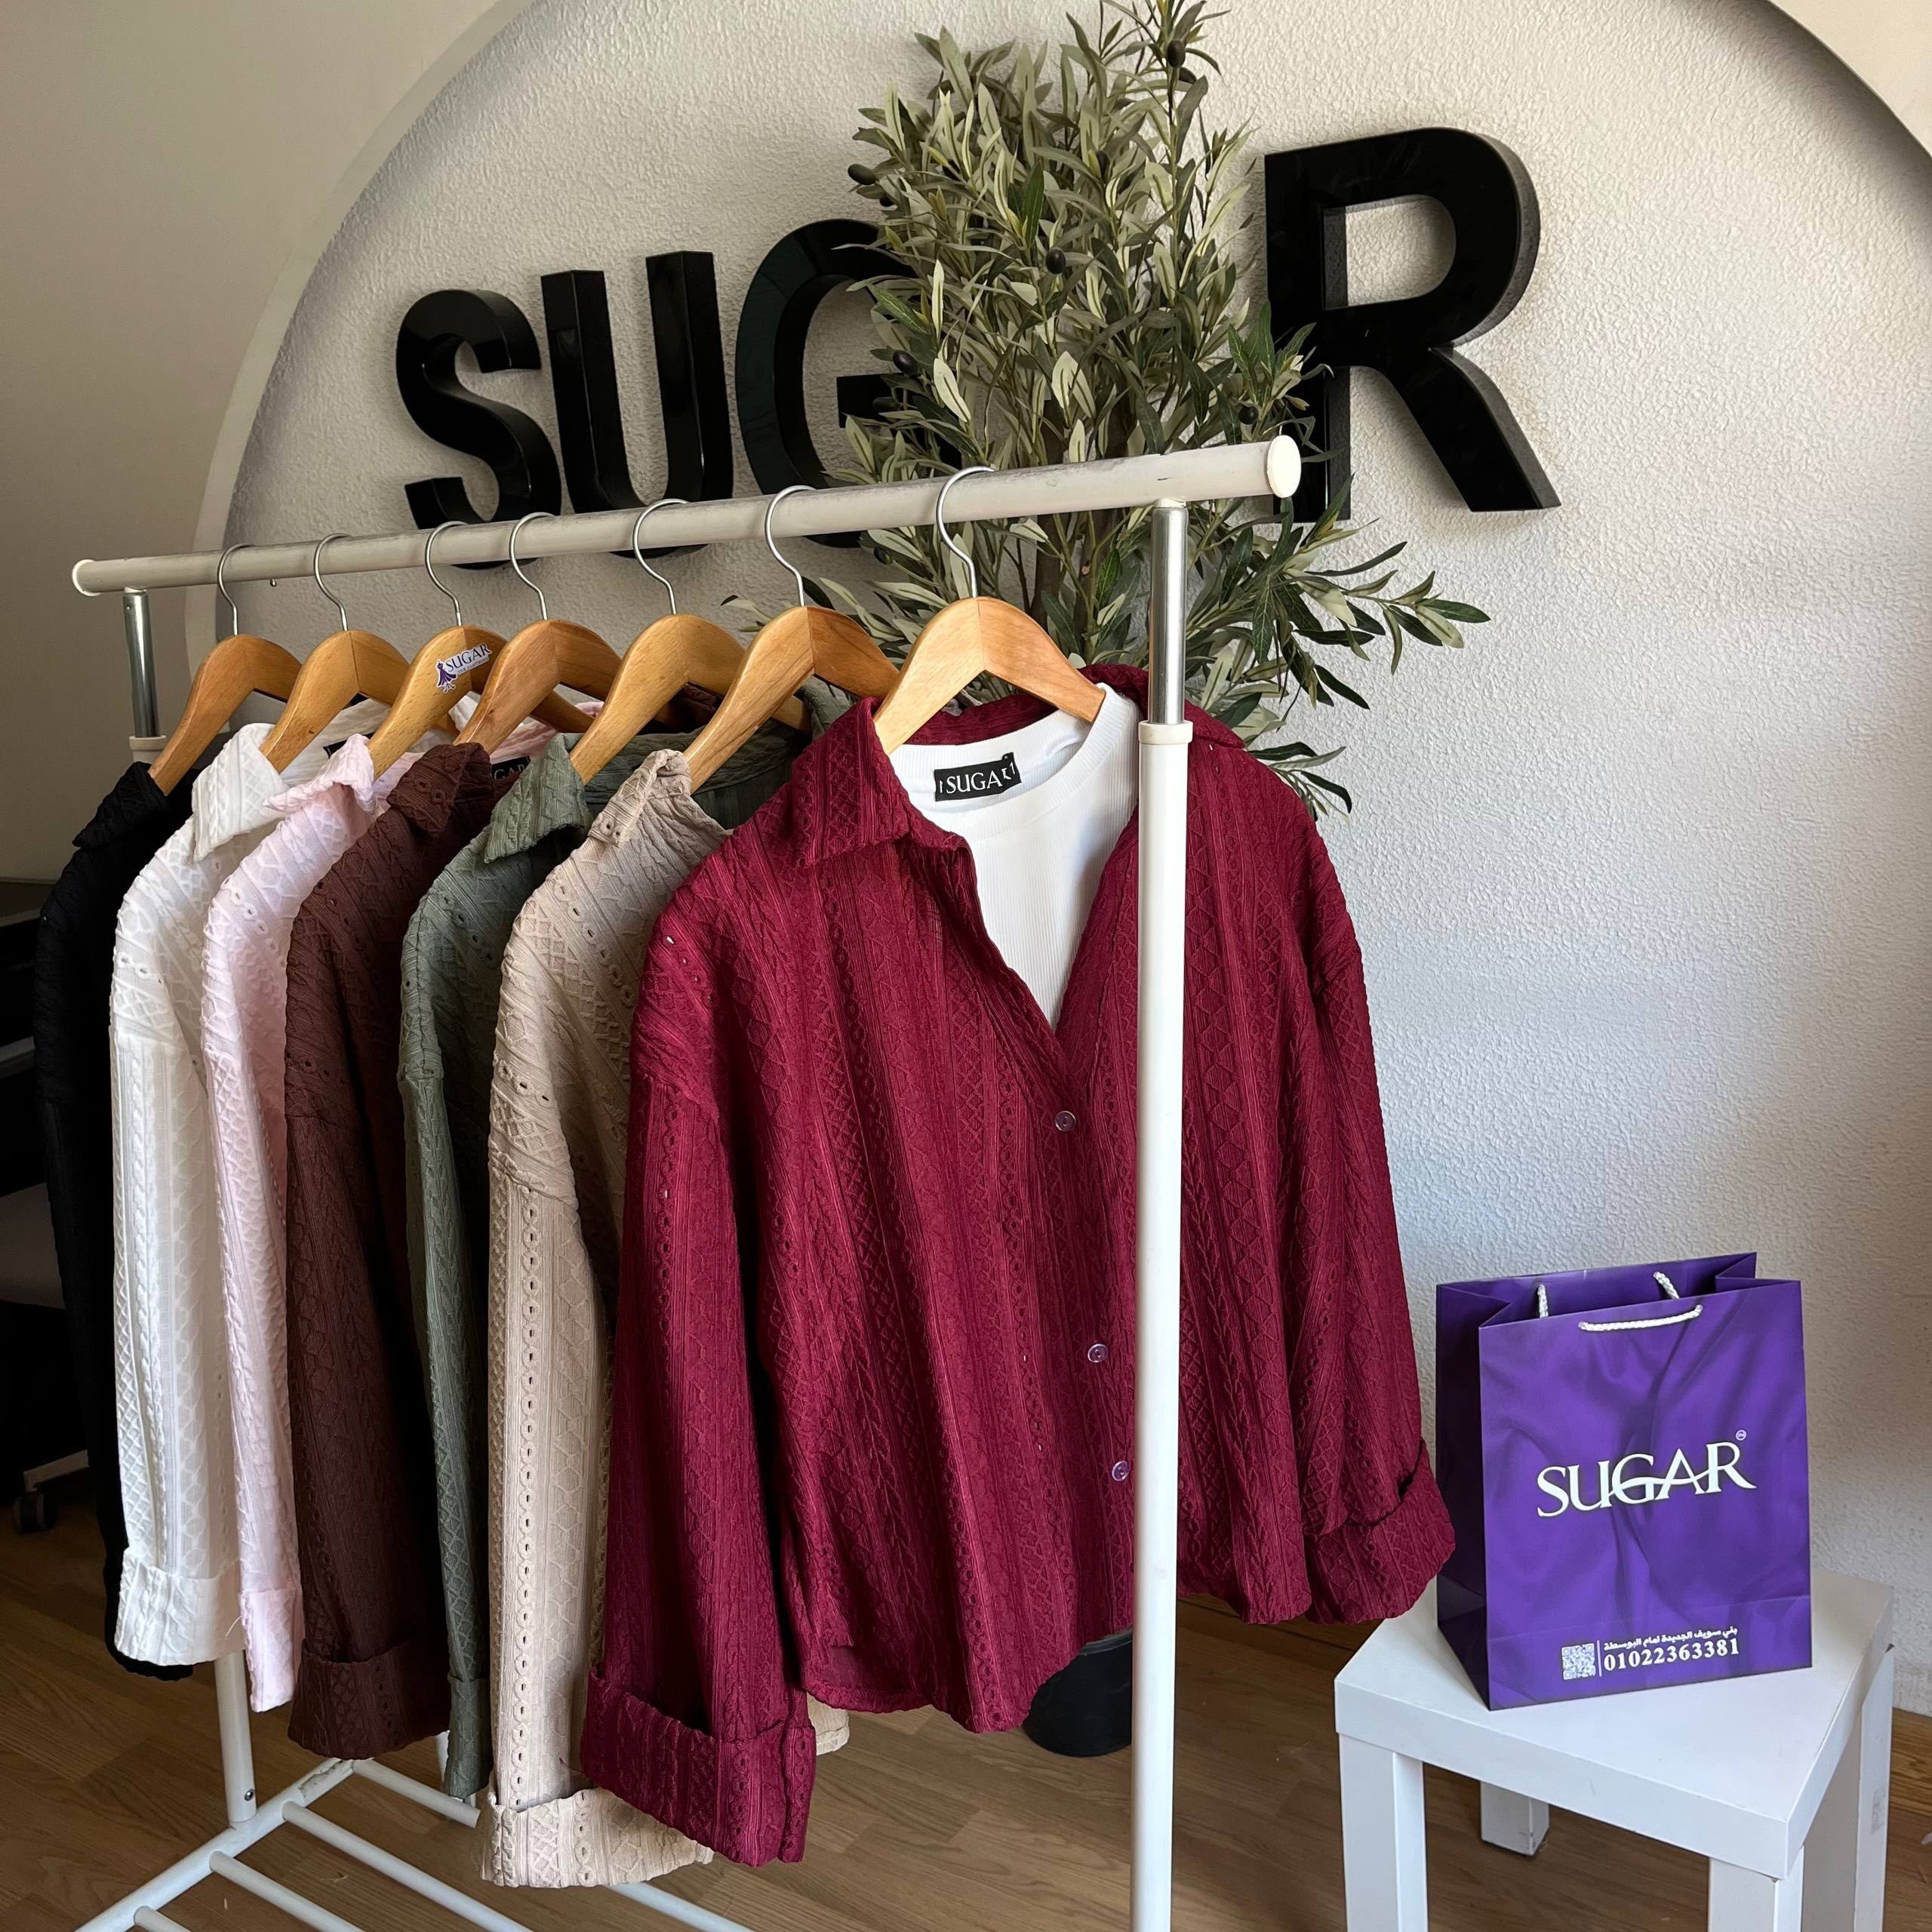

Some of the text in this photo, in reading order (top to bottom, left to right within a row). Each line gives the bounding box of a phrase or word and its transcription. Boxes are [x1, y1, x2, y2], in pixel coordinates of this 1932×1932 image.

[395, 127, 1561, 570] SUGR
[445, 643, 491, 672] SUGAR
[1537, 1442, 1757, 1517] SUGAR
[1604, 1638, 1642, 1651] البوسطة
[1661, 1631, 1693, 1644] الجديدة
[1694, 1629, 1721, 1639] سويف
[1604, 1638, 1739, 1671] 01022363381
